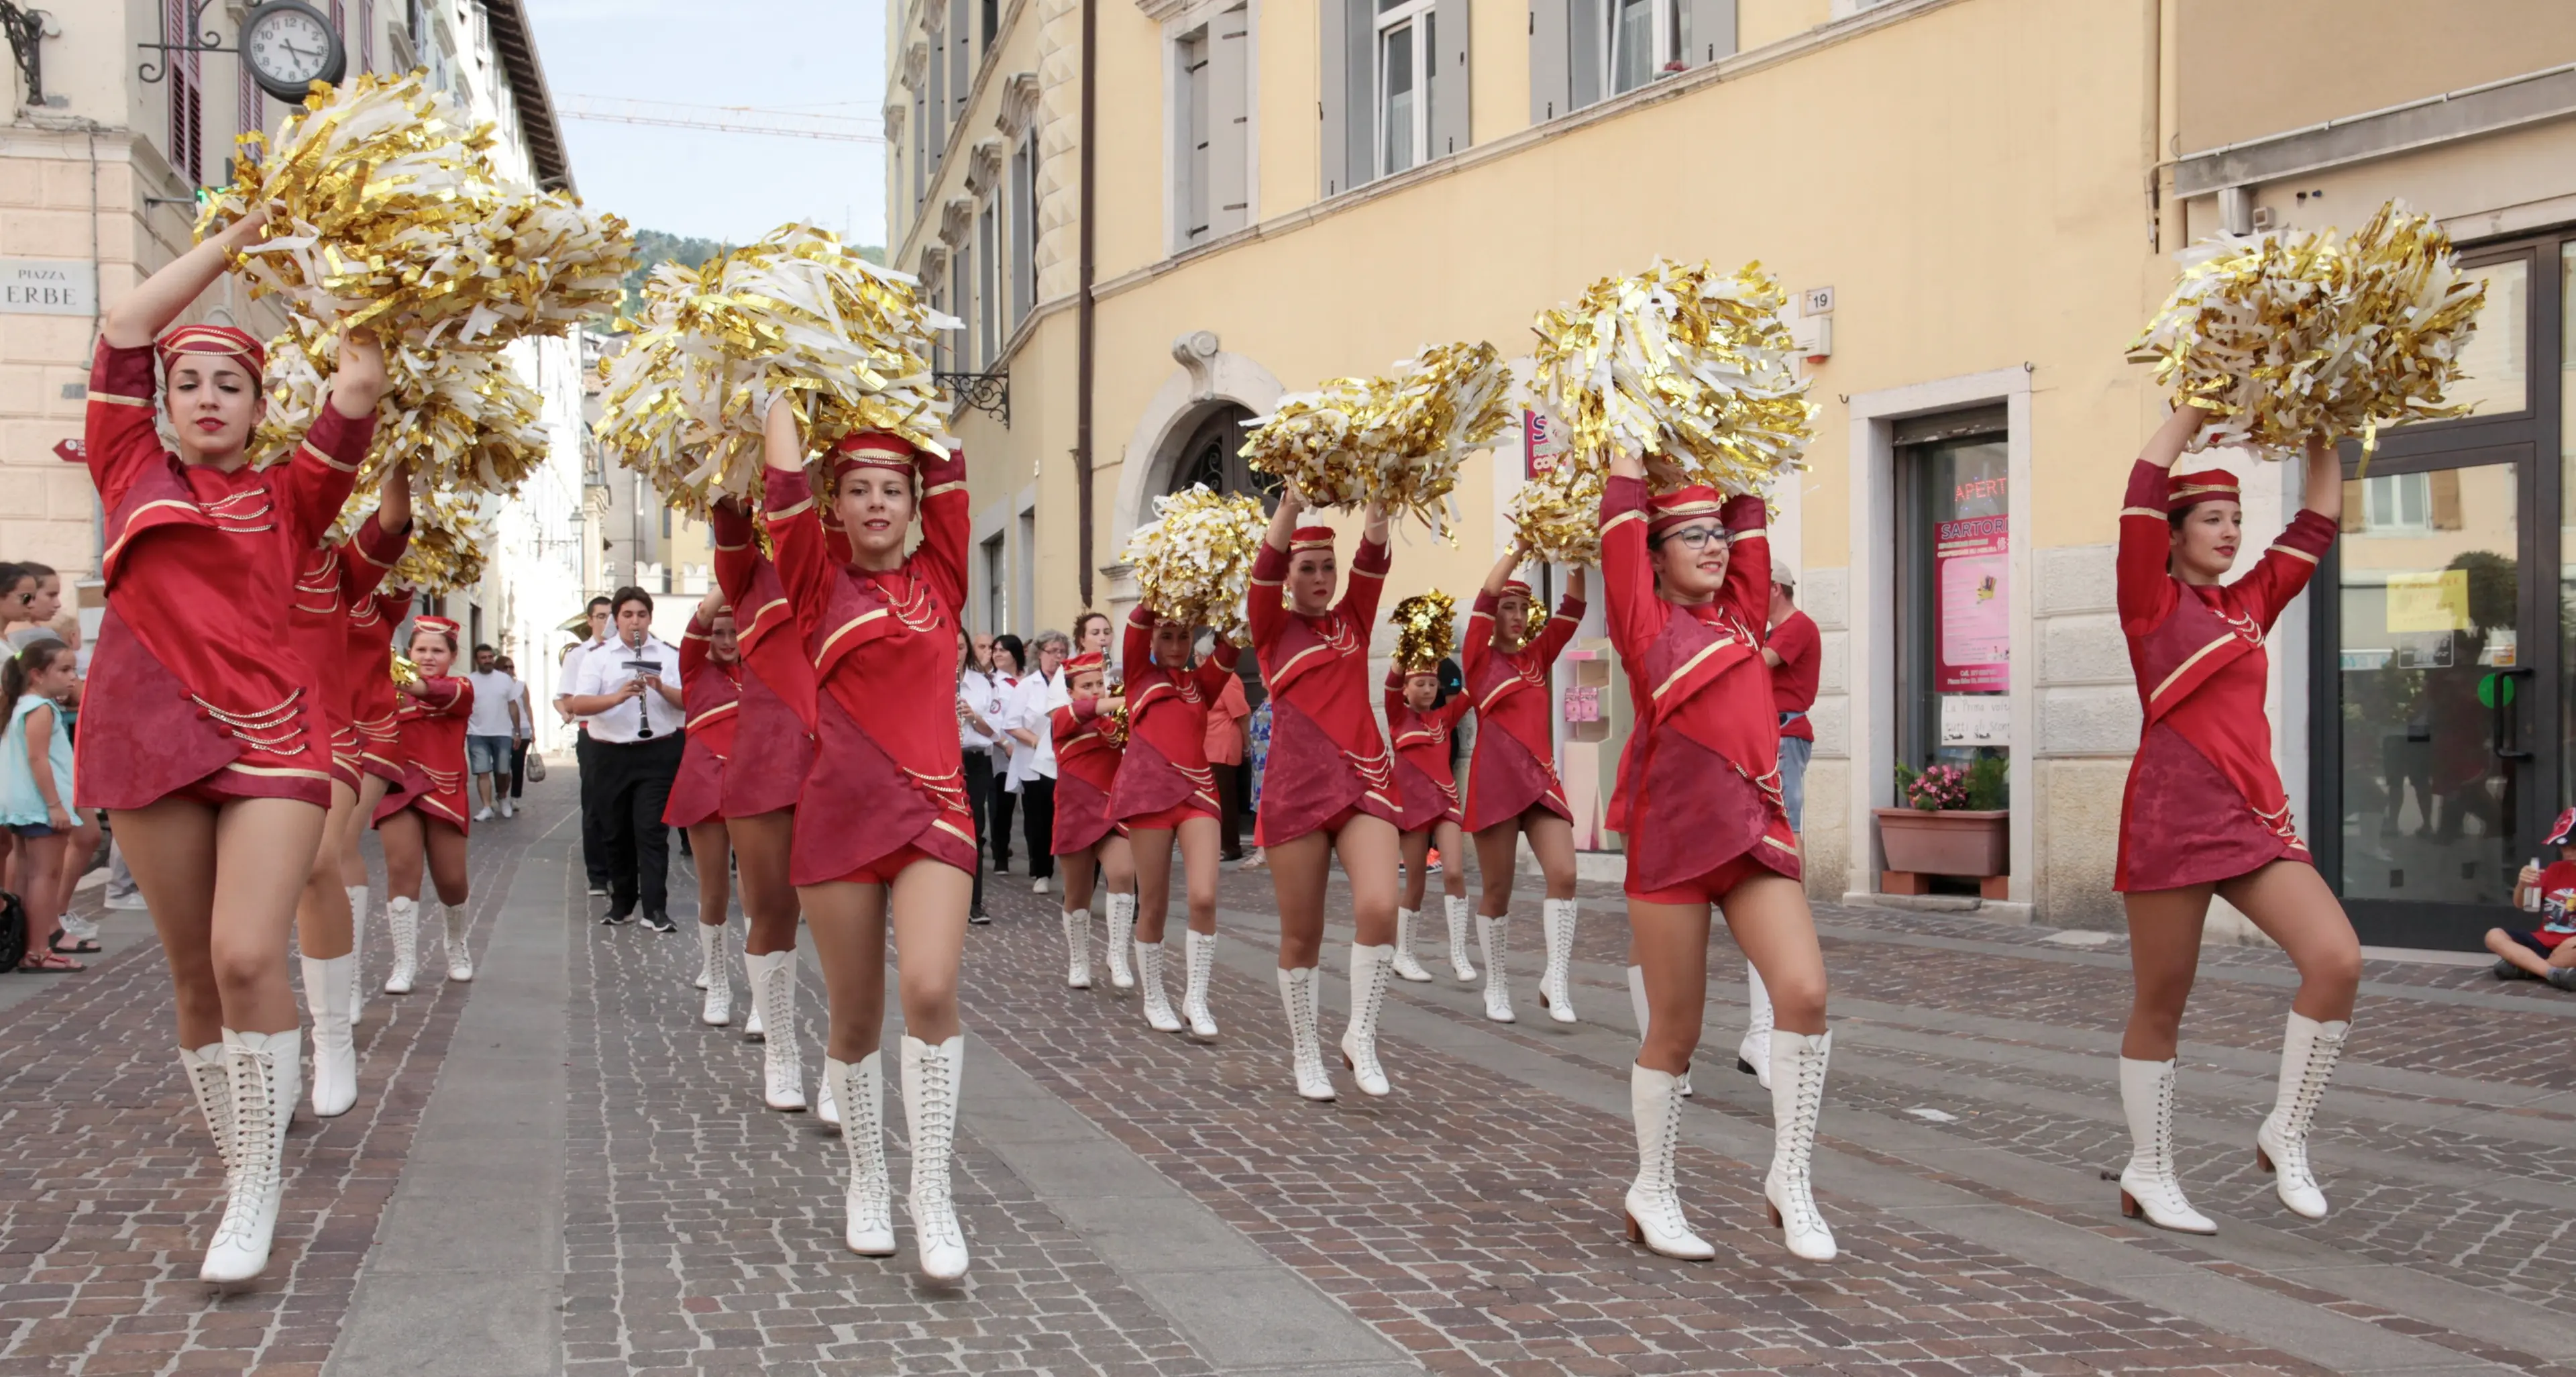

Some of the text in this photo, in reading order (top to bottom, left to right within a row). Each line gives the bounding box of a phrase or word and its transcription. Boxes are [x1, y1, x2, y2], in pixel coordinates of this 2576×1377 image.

[271, 20, 280, 30] 11
[284, 17, 297, 28] 12
[303, 22, 307, 32] 1
[260, 31, 274, 40] 10
[311, 32, 319, 41] 2
[256, 43, 265, 52] 9
[317, 45, 325, 56] 3
[262, 56, 270, 66] 8
[312, 58, 319, 68] 4
[275, 66, 282, 76] 7
[288, 70, 297, 81] 6
[303, 68, 310, 79] 5
[18, 269, 66, 280] PIAZZA
[7, 286, 77, 305] ERBE
[1813, 293, 1828, 309] 19
[1953, 477, 2007, 503] APERT
